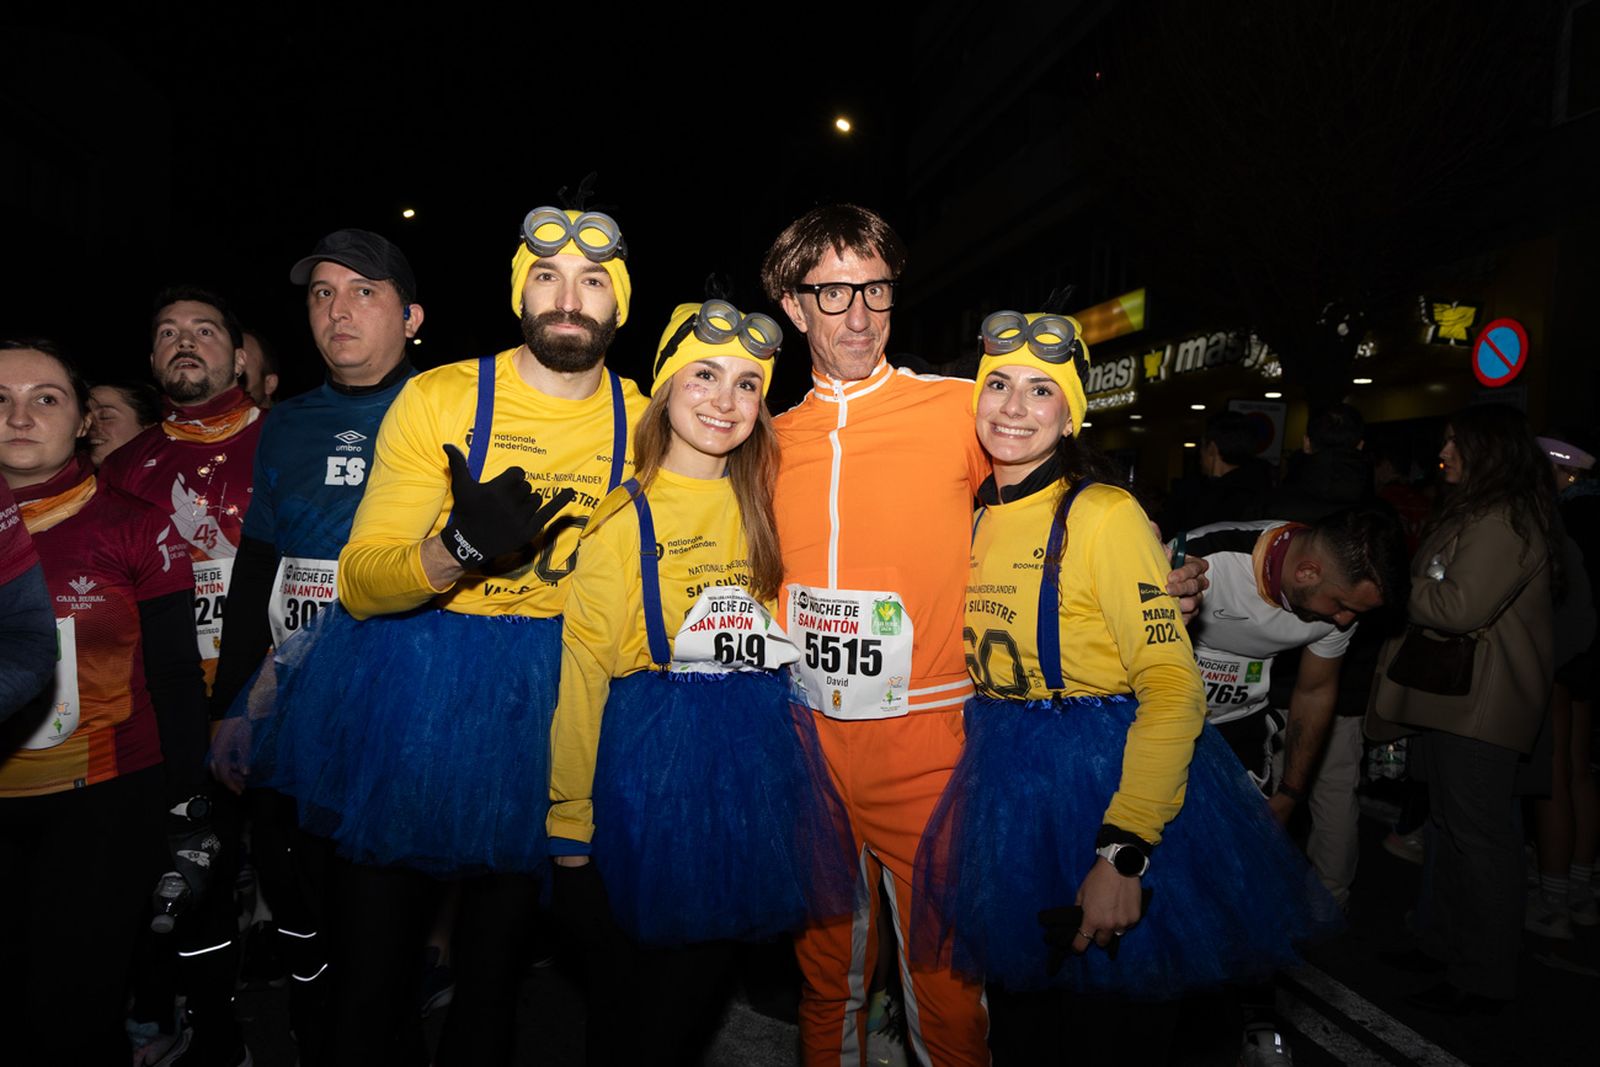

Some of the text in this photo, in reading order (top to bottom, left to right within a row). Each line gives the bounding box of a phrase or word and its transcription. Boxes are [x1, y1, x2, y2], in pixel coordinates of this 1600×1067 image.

[494, 434, 536, 444] nationale
[494, 442, 547, 455] nederlanden
[325, 456, 366, 486] ES
[193, 524, 218, 550] 43
[667, 535, 703, 547] nationale
[668, 541, 717, 556] nederlanden
[209, 570, 222, 580] DE
[292, 571, 334, 584] NOCHE DE
[195, 581, 224, 596] NTÓN
[284, 583, 333, 599] SAN ANTÓN
[739, 601, 754, 613] DE
[809, 601, 842, 616] NOCHE
[844, 604, 860, 618] DE
[969, 599, 1017, 625] SILVESTRE
[798, 613, 817, 629] SAN
[817, 616, 859, 635] ANTÓN
[805, 631, 883, 677] 5515
[1198, 660, 1228, 672] NOCHE
[1229, 665, 1240, 673] DE
[826, 675, 849, 688] David
[1206, 681, 1249, 705] 765
